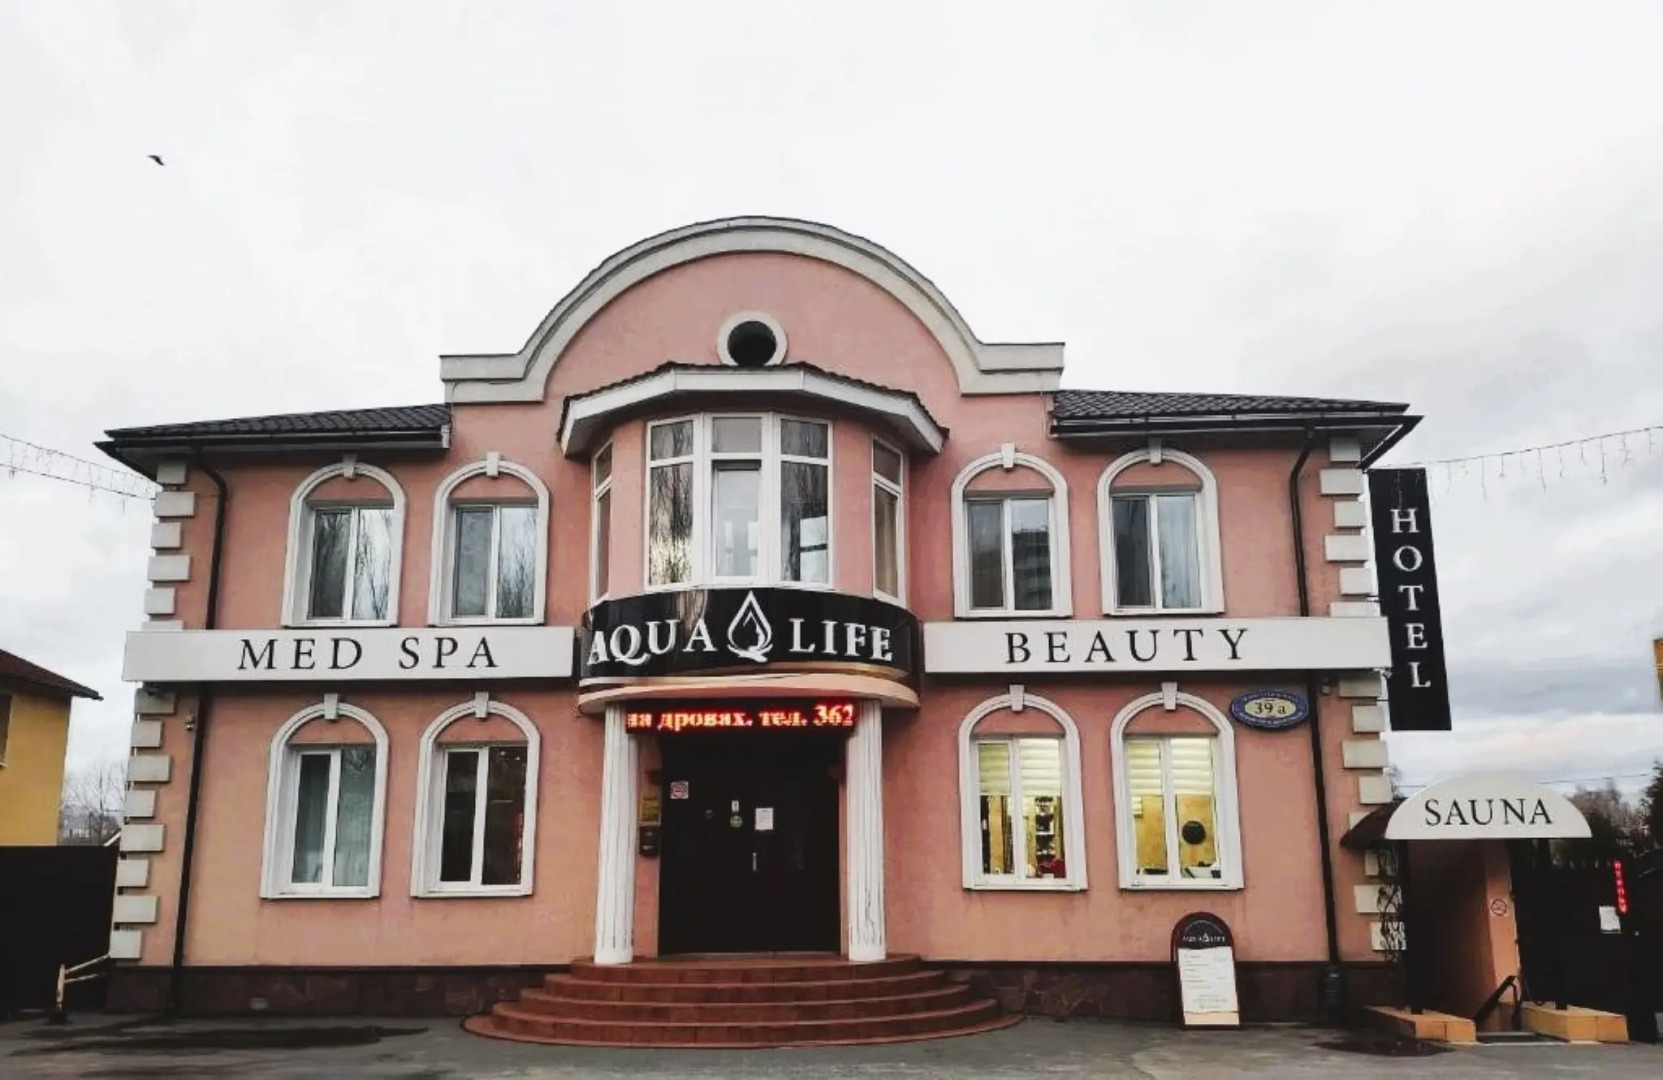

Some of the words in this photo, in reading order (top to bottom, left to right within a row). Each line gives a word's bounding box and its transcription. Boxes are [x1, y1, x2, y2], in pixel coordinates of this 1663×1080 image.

[1390, 508, 1431, 688] HOTEL
[237, 638, 363, 670] MED
[399, 636, 499, 670] SPA
[587, 617, 717, 666] AQUA
[788, 617, 893, 662] LIFE
[1004, 628, 1249, 664] BEAUTY
[1255, 702, 1274, 715] 39
[1424, 798, 1554, 826] SAUNA
